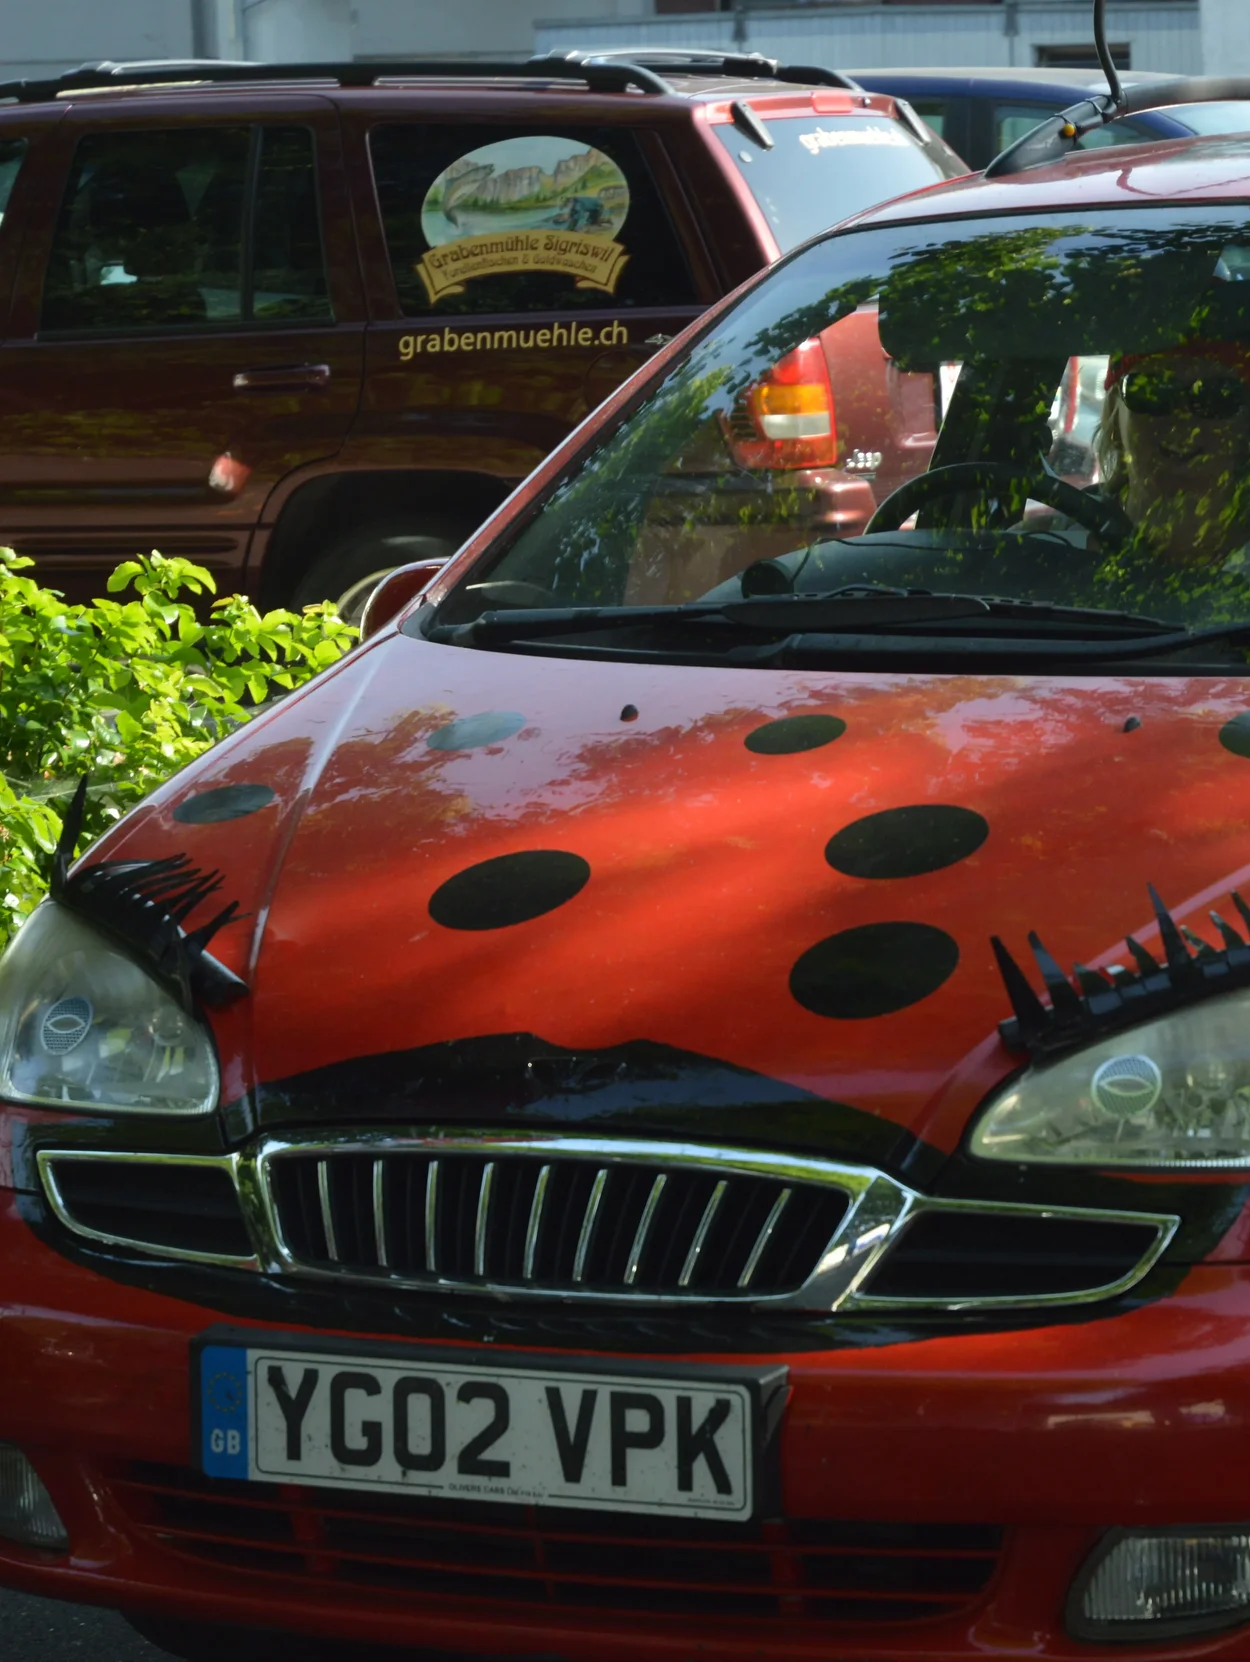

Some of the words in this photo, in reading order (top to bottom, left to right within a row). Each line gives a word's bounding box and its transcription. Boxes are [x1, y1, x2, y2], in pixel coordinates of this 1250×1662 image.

[429, 234, 539, 269] Grabenmühle
[543, 234, 615, 262] Sigriswil
[399, 320, 628, 361] grabenmuehle.ch
[209, 1429, 241, 1455] GB
[266, 1365, 512, 1479] YG02
[544, 1385, 734, 1495] VPK
